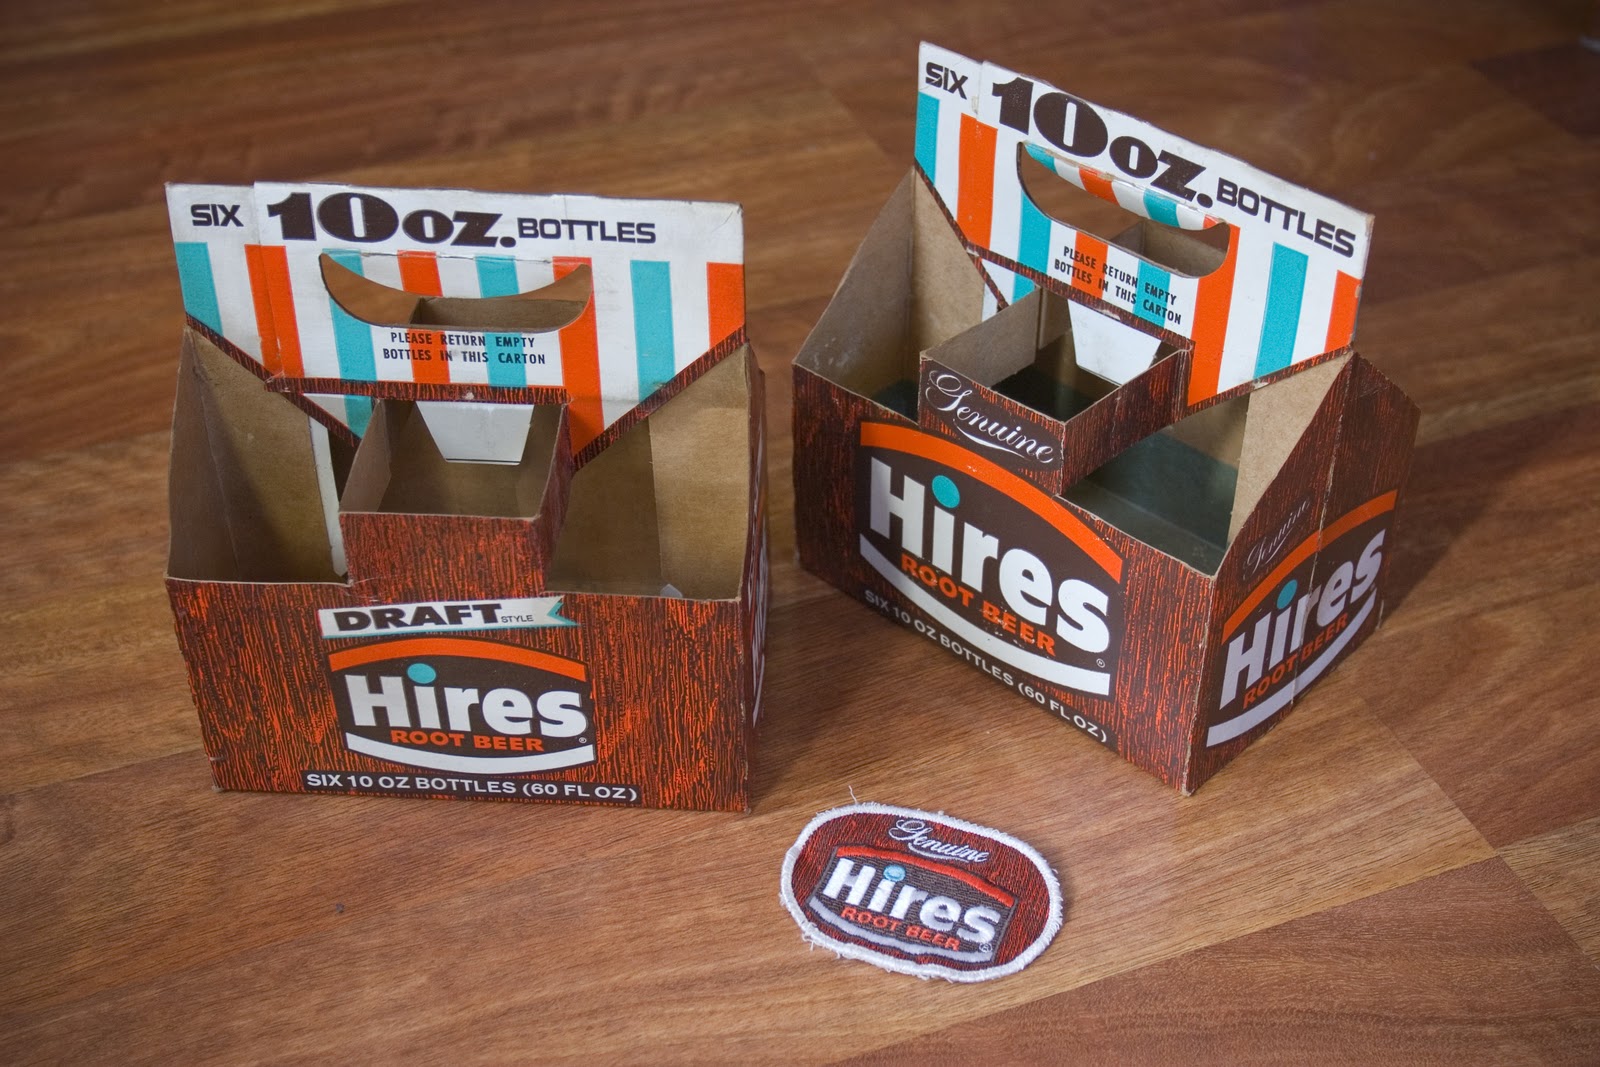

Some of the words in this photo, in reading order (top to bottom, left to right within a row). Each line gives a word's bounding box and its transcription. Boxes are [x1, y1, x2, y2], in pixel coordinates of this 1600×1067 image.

[925, 61, 968, 100] SIX
[1216, 177, 1356, 258] BOTTLES
[190, 203, 244, 227] SIX
[517, 217, 656, 244] BOTTLES
[1054, 259, 1092, 284] BOTTLES
[1098, 278, 1108, 292] IN
[1115, 285, 1137, 304] THIS
[1143, 300, 1181, 325] CARTON
[1063, 246, 1096, 269] PLEASE
[1102, 263, 1138, 288] RETURN
[1144, 282, 1177, 305] EMPTY
[383, 348, 432, 361] BOTTLES
[440, 350, 453, 361] IN
[463, 351, 489, 363] THIS
[498, 352, 546, 365] CARTON
[390, 332, 433, 344] PLEASE
[440, 334, 486, 346] RETURN
[495, 336, 535, 348] EMPTY
[925, 370, 1054, 465] Genuine
[870, 456, 1111, 654] Hires
[333, 604, 503, 632] DRAFT
[501, 614, 534, 624] STYLE
[901, 552, 974, 608] ROOT
[982, 601, 1056, 657] BEER
[1219, 529, 1386, 710] Hires
[865, 589, 890, 612] SIX
[892, 606, 911, 624] 10
[914, 619, 937, 641] OZ
[939, 634, 1014, 687] BOTTLES
[1017, 682, 1045, 705] (60
[1049, 700, 1071, 721] FL
[1073, 711, 1108, 743] OZ)
[1243, 650, 1299, 710] ROOT
[1301, 612, 1348, 663] BEER
[344, 662, 588, 738] Hires
[390, 729, 468, 747] ROOT
[473, 735, 545, 751] BEER
[306, 774, 343, 788] SIX
[349, 775, 373, 788] 10
[378, 776, 411, 789] OZ
[415, 777, 517, 794] BOTTLES
[522, 783, 558, 797] (60
[563, 784, 591, 797] FL
[595, 786, 637, 801] OZ)
[888, 818, 991, 864] Genuine
[822, 857, 1002, 945] Hires
[840, 908, 899, 931] ROOT
[905, 925, 960, 951] BEER
